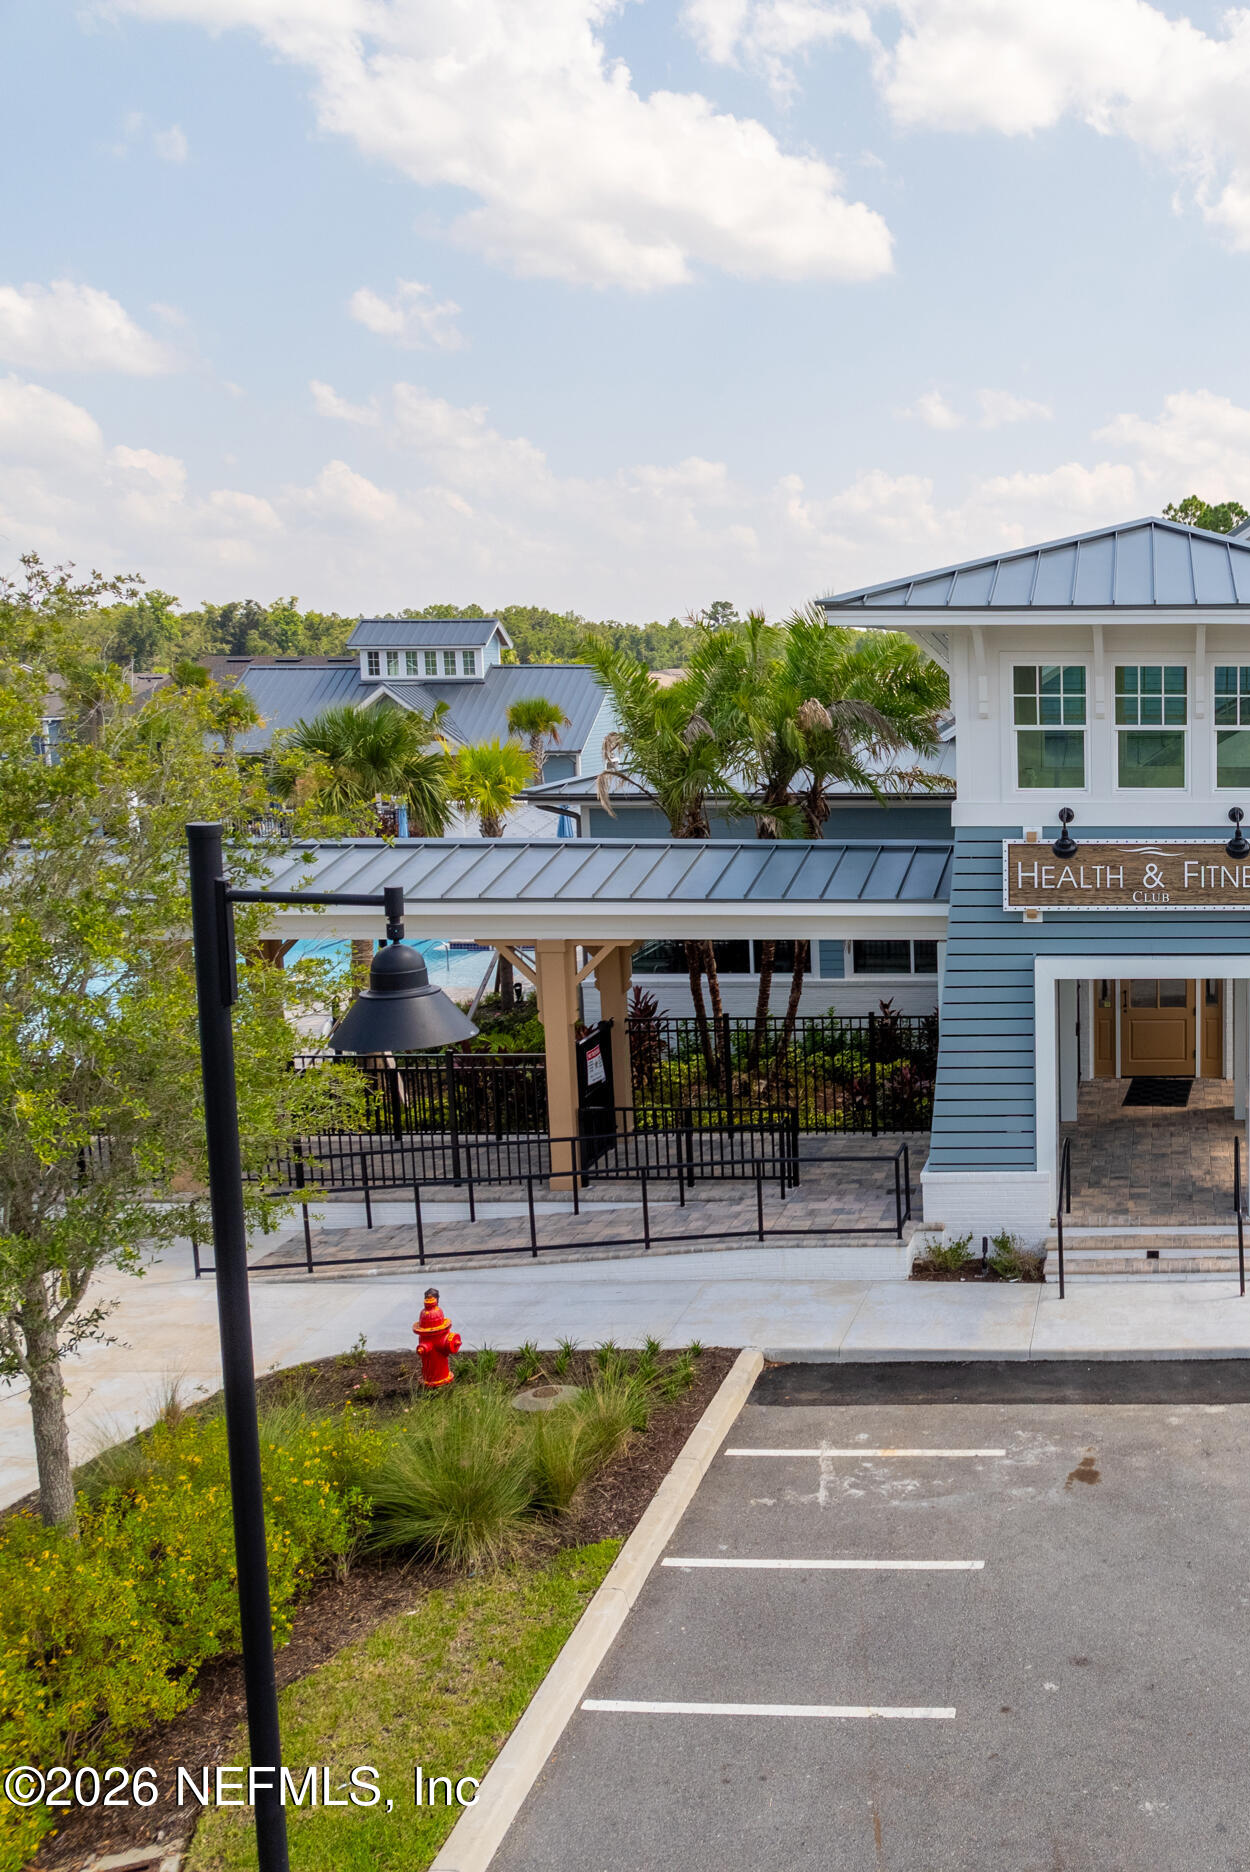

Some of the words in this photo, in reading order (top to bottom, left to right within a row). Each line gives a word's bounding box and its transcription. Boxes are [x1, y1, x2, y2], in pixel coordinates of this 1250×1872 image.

[1017, 861, 1124, 889] HEALTH
[1142, 863, 1166, 889] &
[1132, 890, 1170, 903] CLUB
